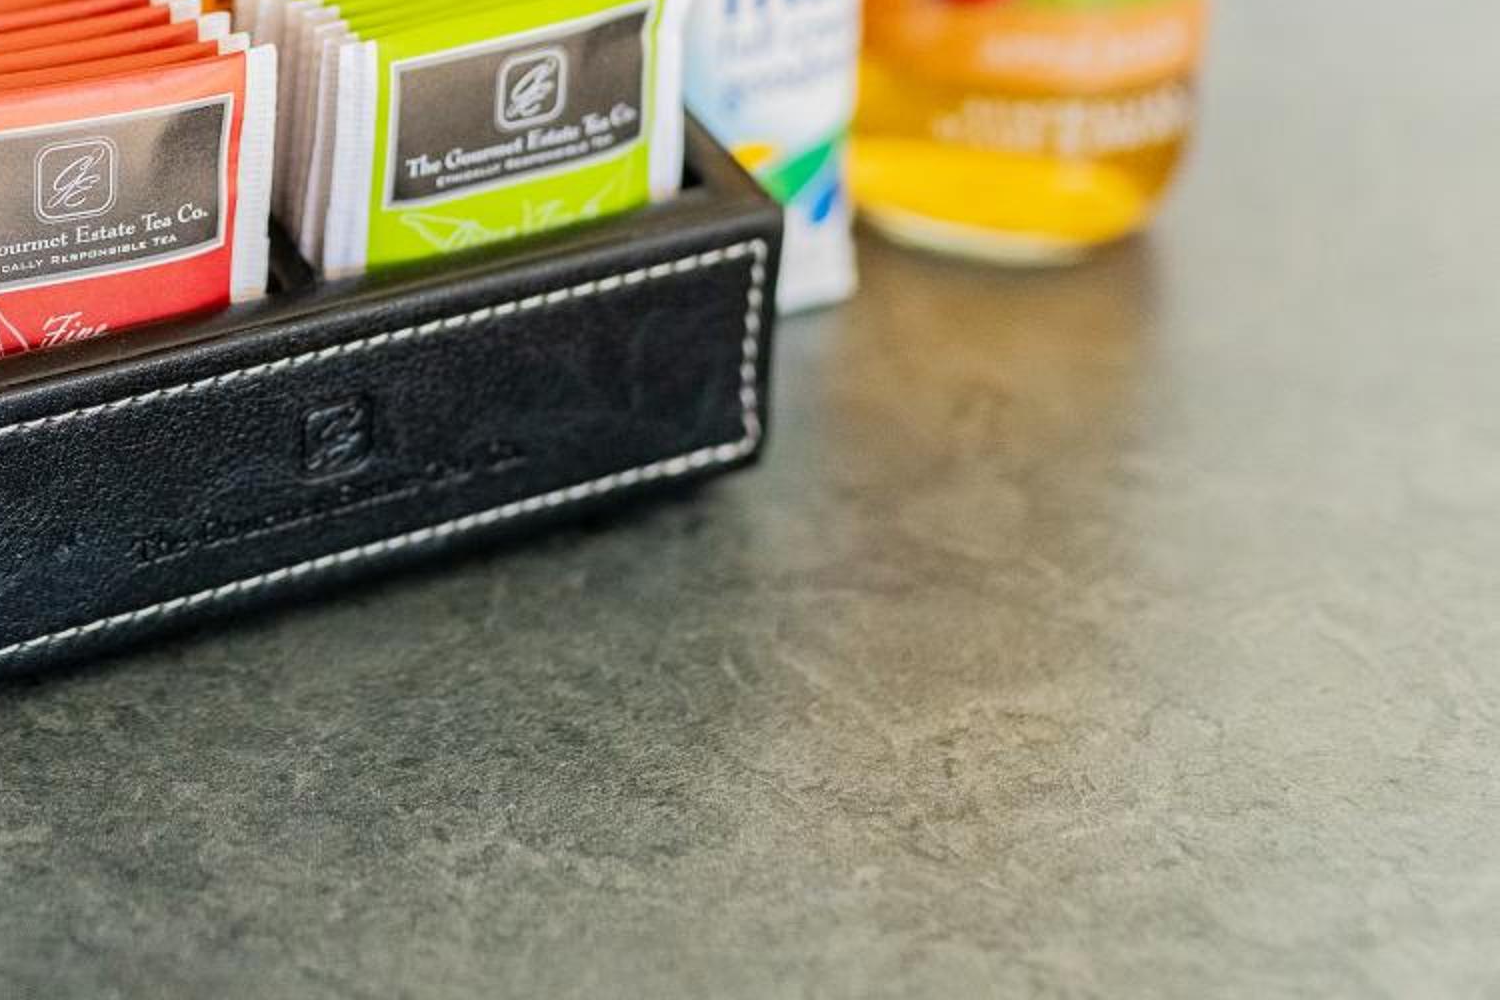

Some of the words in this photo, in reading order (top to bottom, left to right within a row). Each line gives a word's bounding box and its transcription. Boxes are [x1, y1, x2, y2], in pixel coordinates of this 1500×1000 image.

[406, 156, 442, 178] The
[445, 137, 523, 169] Gourmet
[527, 126, 580, 151] Estate
[582, 112, 609, 134] Tea
[75, 222, 135, 244] Estate
[142, 213, 172, 231] Tea
[177, 201, 209, 222] Co.
[50, 241, 147, 265] RESPONSIBLE
[153, 234, 178, 247] TEA
